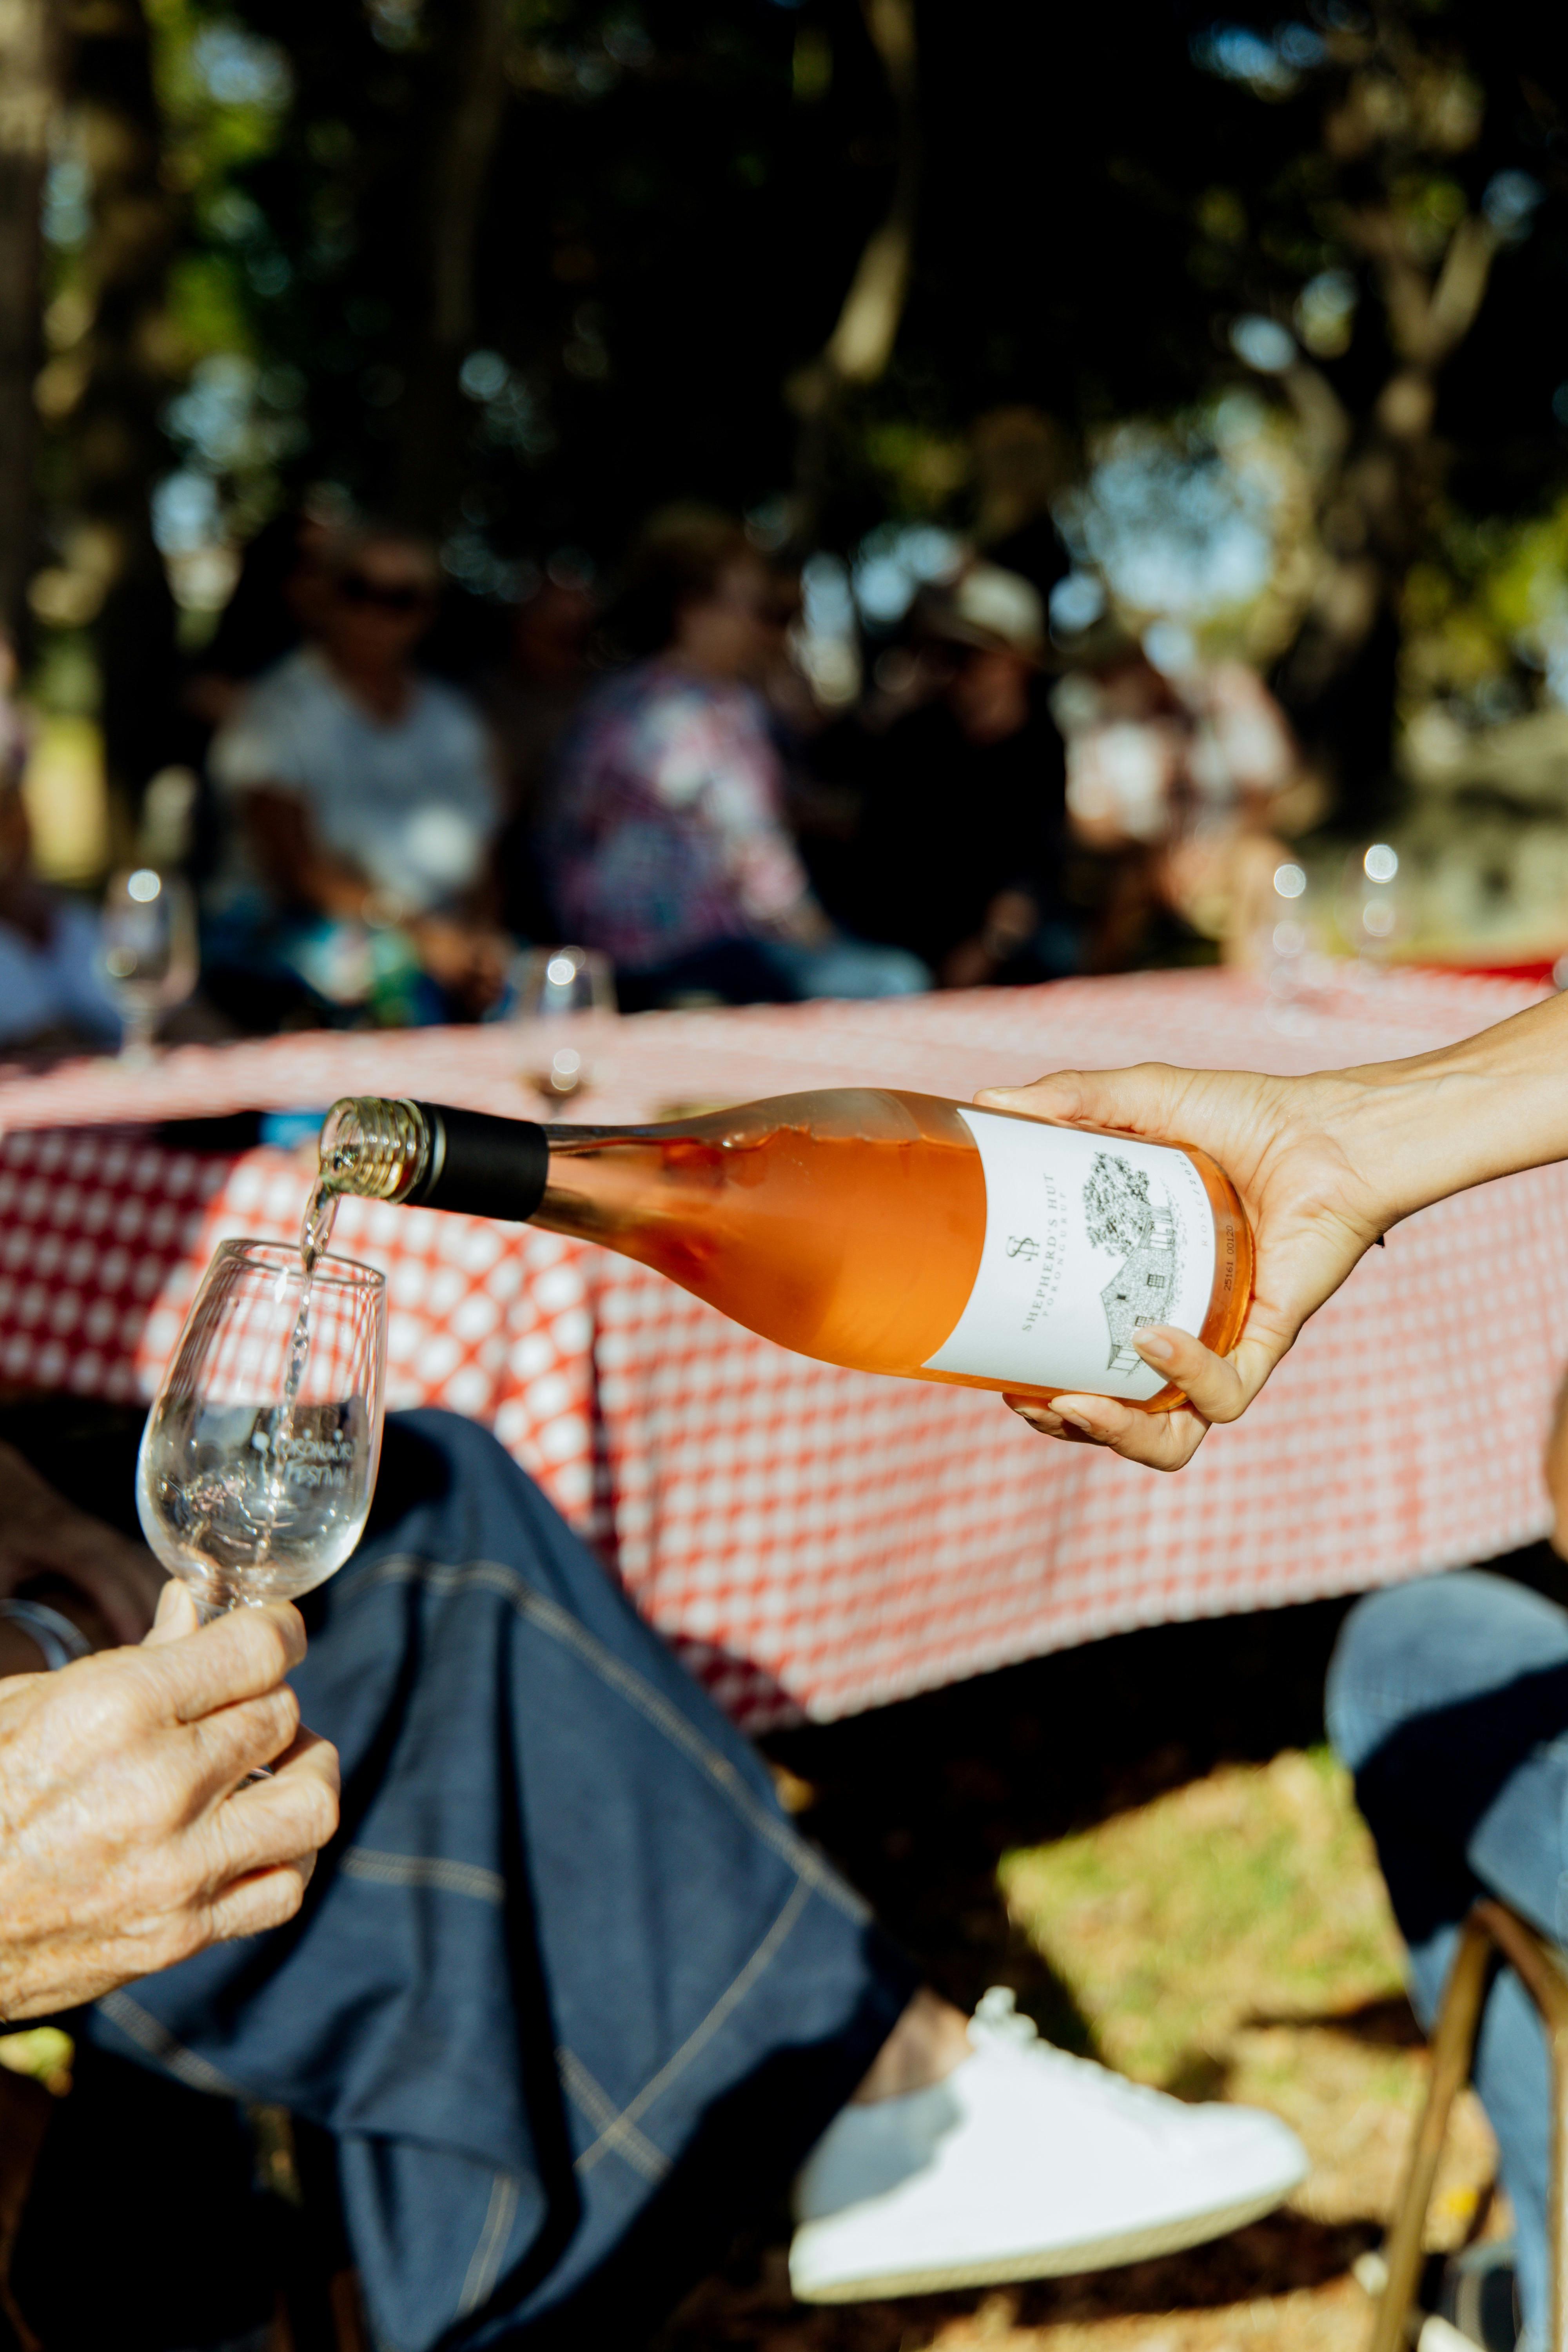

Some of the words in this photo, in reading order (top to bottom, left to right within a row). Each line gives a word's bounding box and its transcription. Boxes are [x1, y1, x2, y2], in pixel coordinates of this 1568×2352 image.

[1022, 1218, 1058, 1332] SHEPHERD'S
[1044, 1172, 1058, 1210] HUT
[1042, 1192, 1067, 1317] PORONGURUP
[1223, 1261, 1234, 1291] 25161
[1226, 1225, 1234, 1255] 00120
